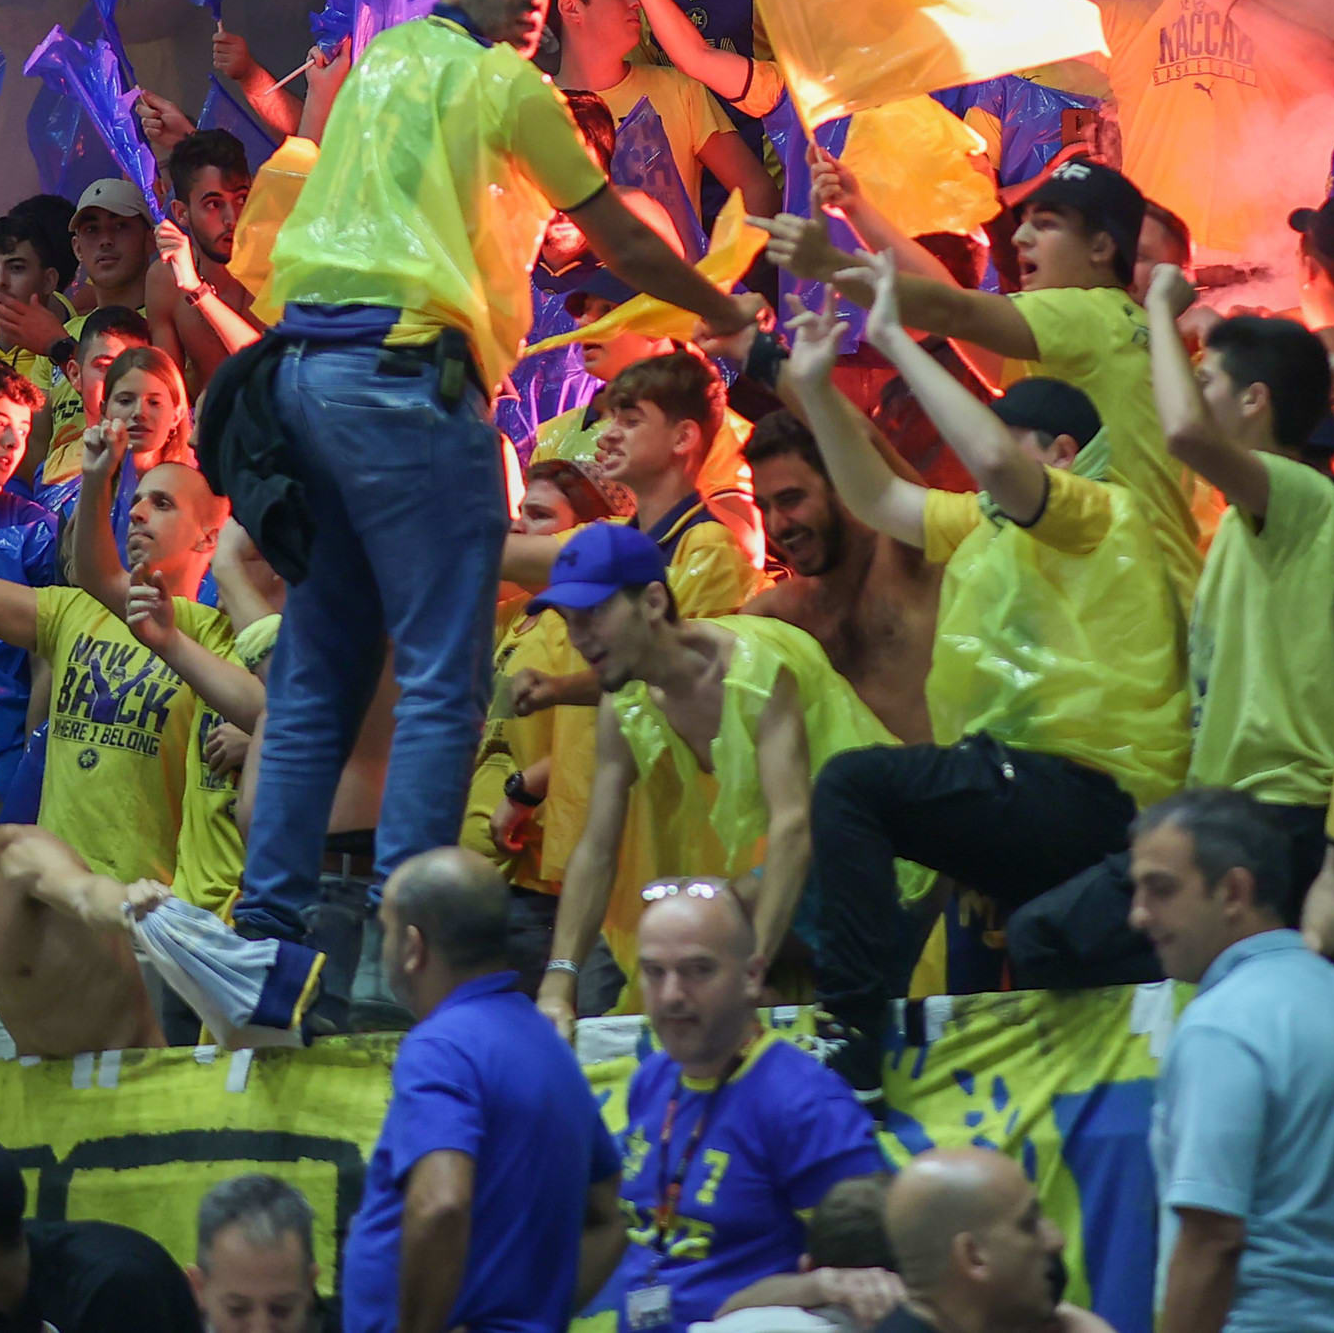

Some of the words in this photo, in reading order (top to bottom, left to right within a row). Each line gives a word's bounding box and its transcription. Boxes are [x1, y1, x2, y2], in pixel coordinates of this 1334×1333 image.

[67, 632, 140, 671] NOW
[57, 665, 178, 733] BACK
[89, 725, 99, 743] I
[100, 728, 161, 756] BELONG
